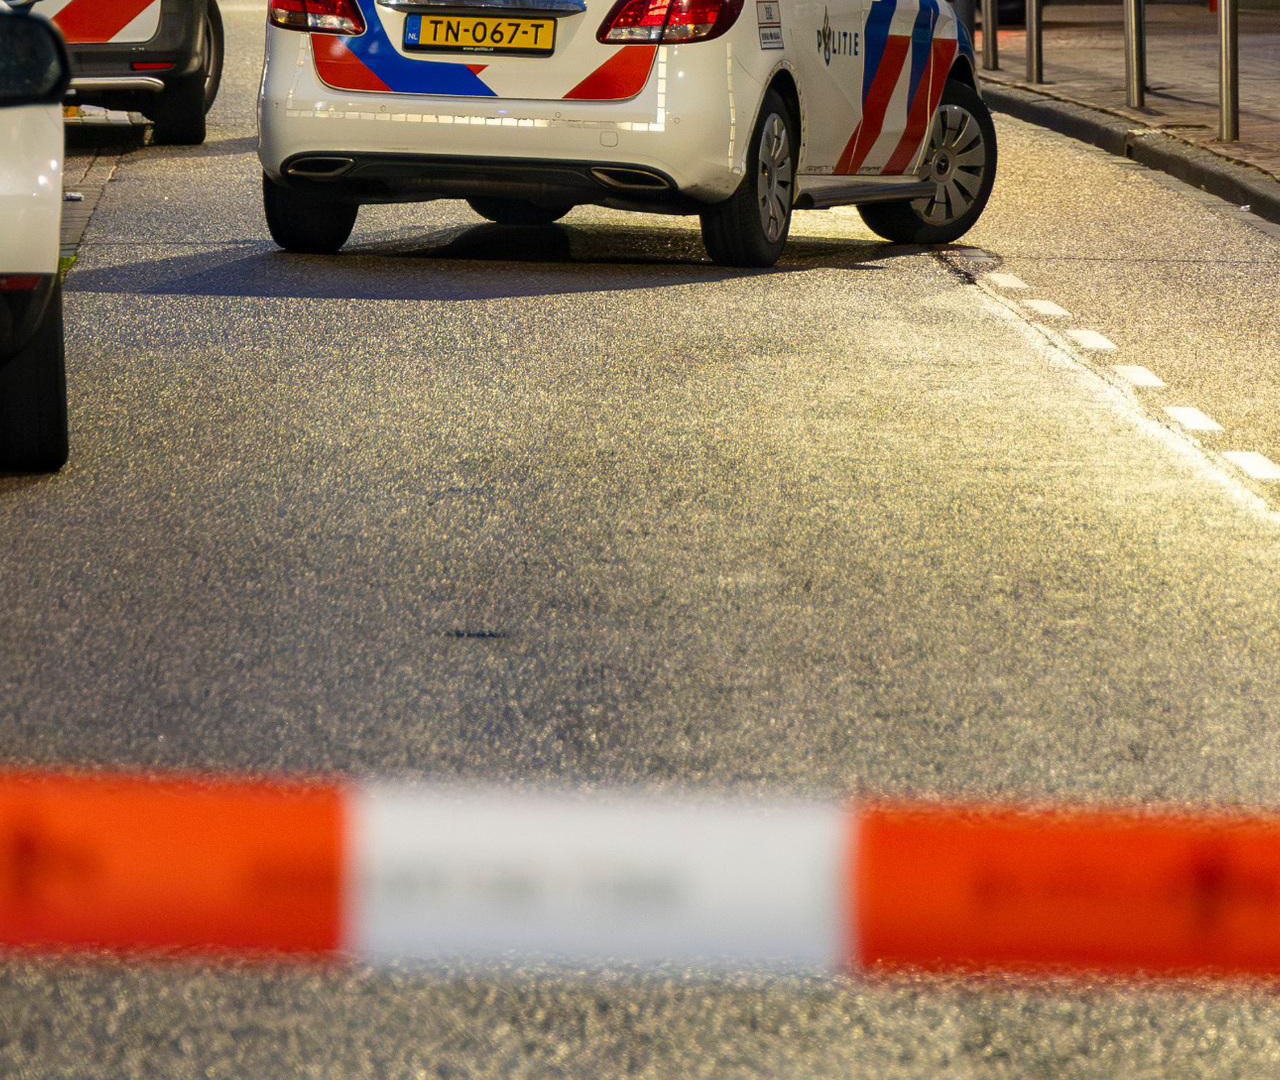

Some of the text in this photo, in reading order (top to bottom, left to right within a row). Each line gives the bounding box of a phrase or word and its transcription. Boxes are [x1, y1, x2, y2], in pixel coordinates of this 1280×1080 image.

[407, 20, 545, 45] NL TN-067-T
[815, 18, 859, 60] POLITIE
